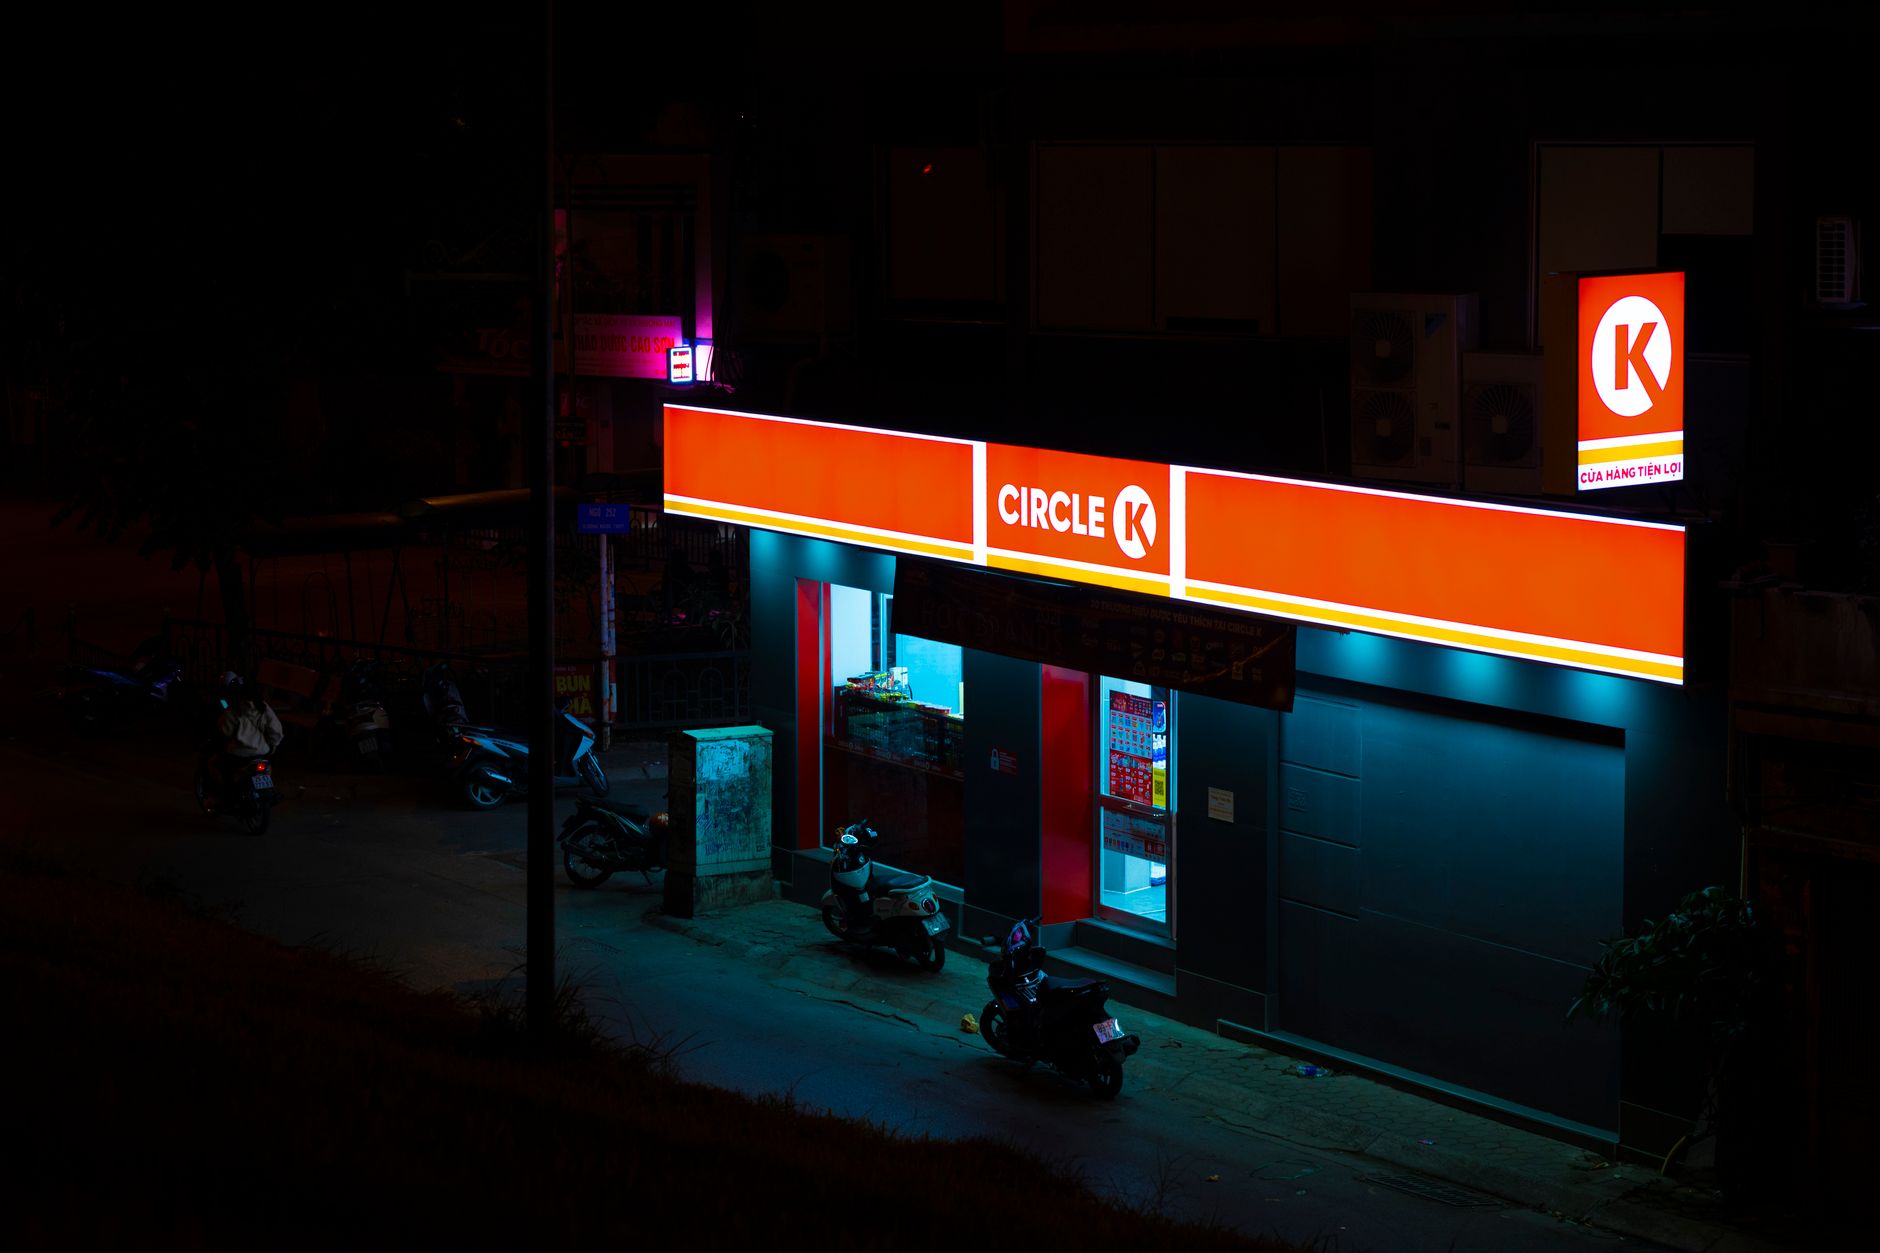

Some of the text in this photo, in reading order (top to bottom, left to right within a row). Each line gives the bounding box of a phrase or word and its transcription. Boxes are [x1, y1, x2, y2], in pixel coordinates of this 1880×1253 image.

[630, 335, 651, 353] CAO
[1580, 461, 1682, 484] CỬA HÀNG TIỆN LỢI
[998, 483, 1105, 539] CIRCLE
